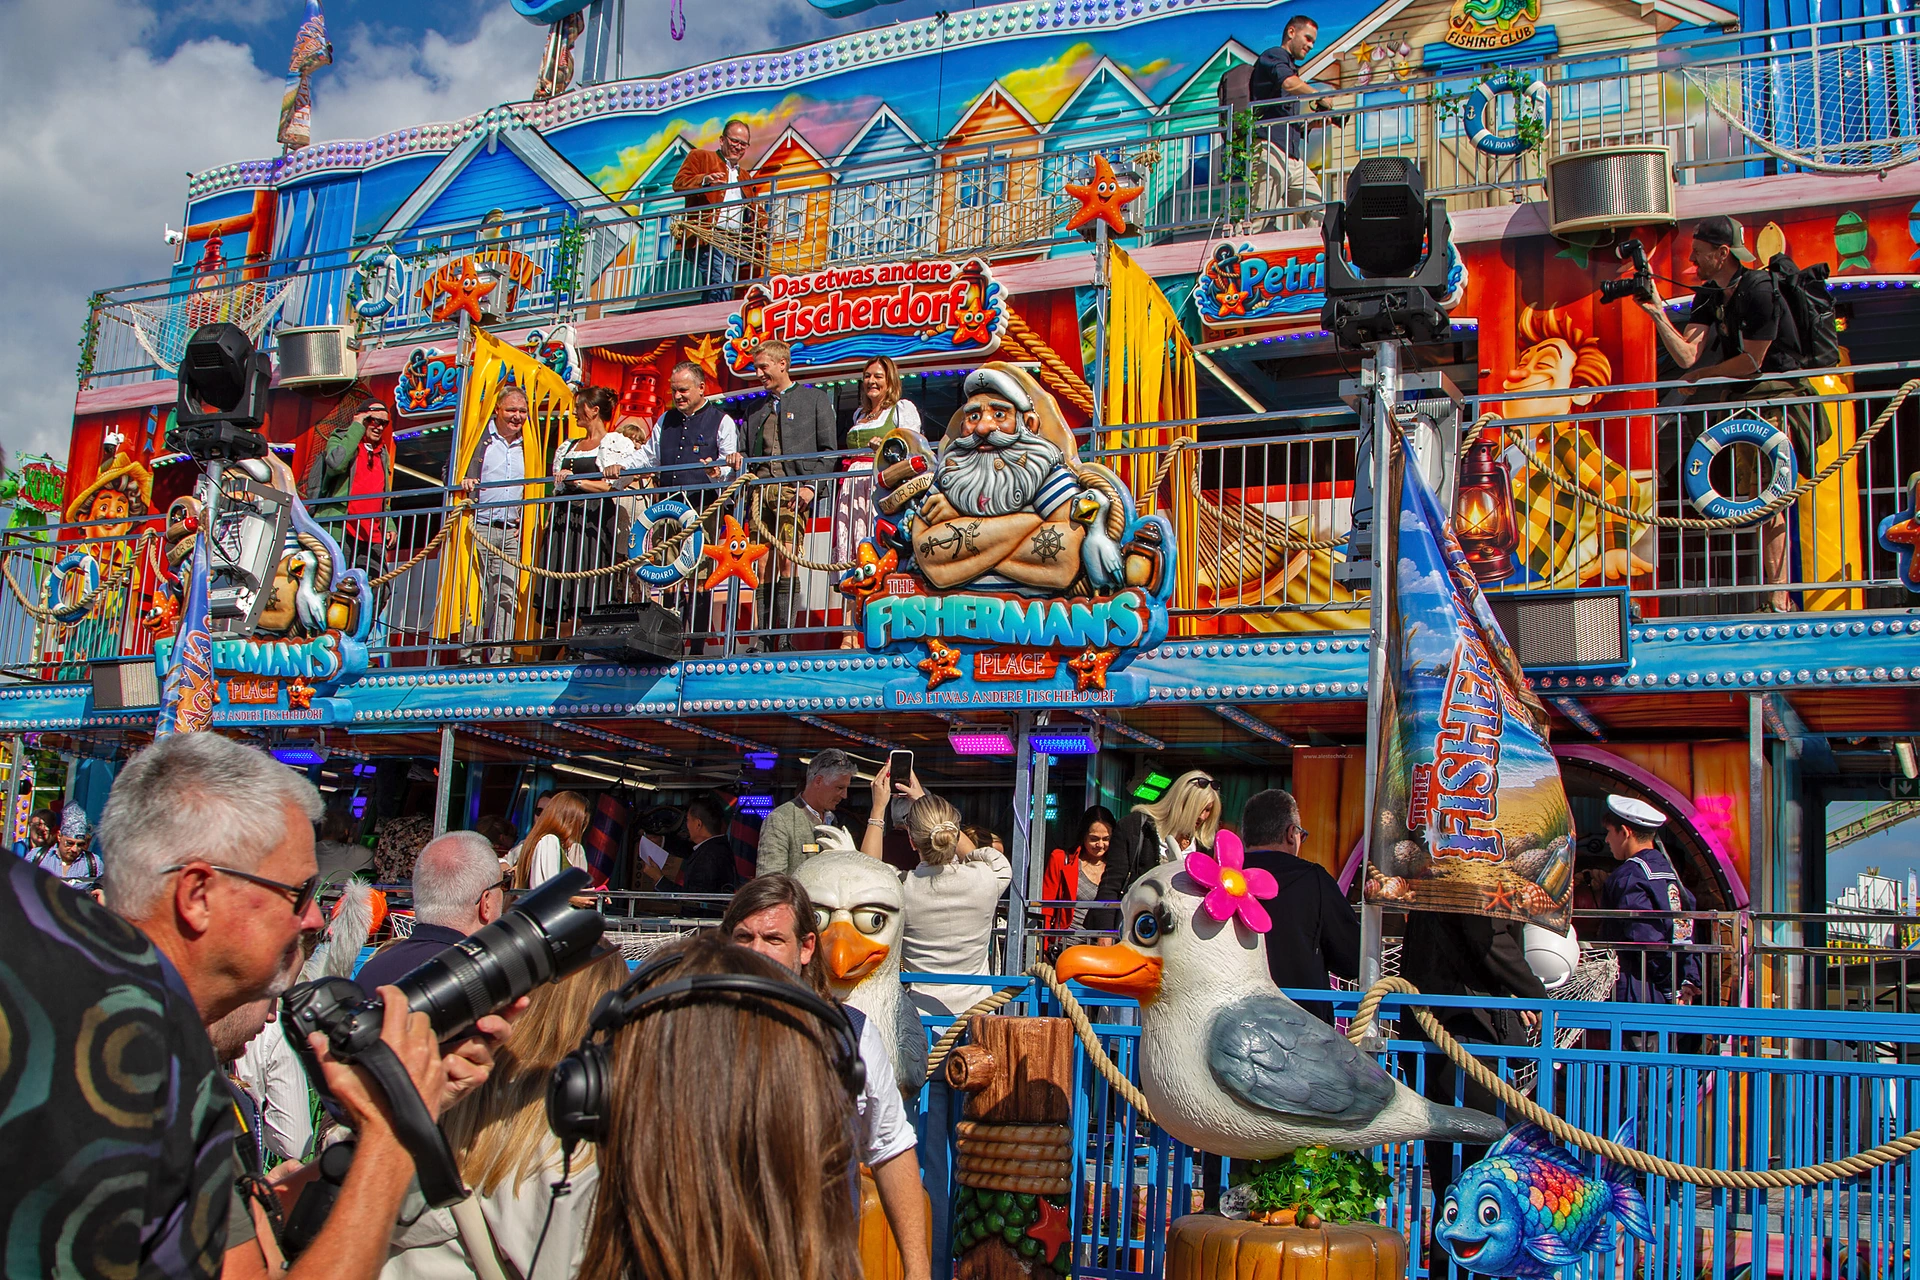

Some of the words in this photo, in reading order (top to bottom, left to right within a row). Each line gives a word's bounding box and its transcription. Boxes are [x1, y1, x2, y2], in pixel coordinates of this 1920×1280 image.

[1447, 31, 1497, 48] FISHING
[1500, 26, 1532, 45] CLUB
[1482, 138, 1494, 147] ON
[772, 277, 811, 299] Das
[813, 265, 875, 291] etwas
[877, 262, 951, 284] andere
[1240, 252, 1325, 299] Petri
[762, 283, 968, 341] Fischerdorf
[1721, 423, 1770, 438] WELCOME
[25, 468, 63, 506] KONG
[894, 489, 908, 504] OR
[651, 503, 684, 515] WELCOME
[1711, 503, 1727, 516] ON
[640, 568, 650, 578] ON
[650, 568, 674, 580] BOARD
[887, 578, 915, 594] THE
[866, 591, 1144, 649] FISHERMAN'S
[155, 634, 340, 678] FERMAN'S
[980, 653, 1045, 675] PLACE
[231, 681, 275, 700] PLACE
[896, 690, 922, 705] DAS
[926, 689, 970, 704] ETWAS
[972, 689, 1022, 704] ANDERE
[1026, 687, 1117, 703] FISCHERDORF
[226, 709, 260, 721] ANDERE
[263, 707, 323, 721] FISCHERDORF
[1411, 769, 1430, 823] THE
